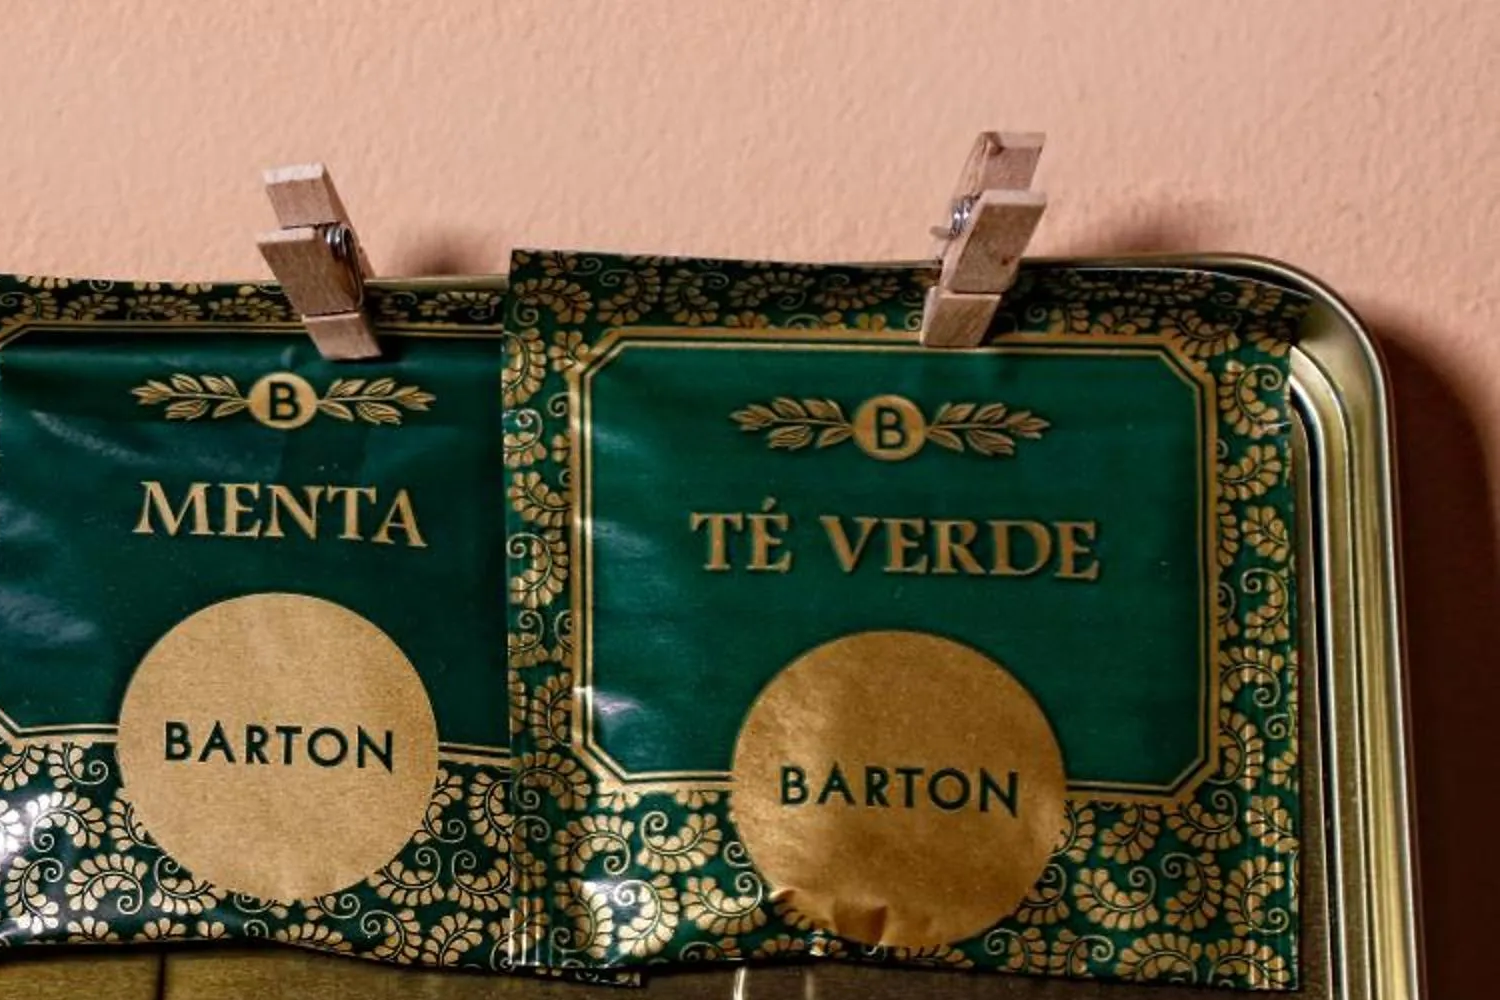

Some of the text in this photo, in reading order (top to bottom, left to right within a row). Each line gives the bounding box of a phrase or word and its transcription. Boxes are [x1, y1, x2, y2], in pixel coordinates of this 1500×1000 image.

[269, 381, 302, 422] B
[874, 405, 907, 450] B
[132, 480, 429, 548] MENTA
[691, 497, 1101, 581] TÉ VERDE
[164, 720, 396, 775] BARTON
[779, 766, 1019, 817] BARTON
